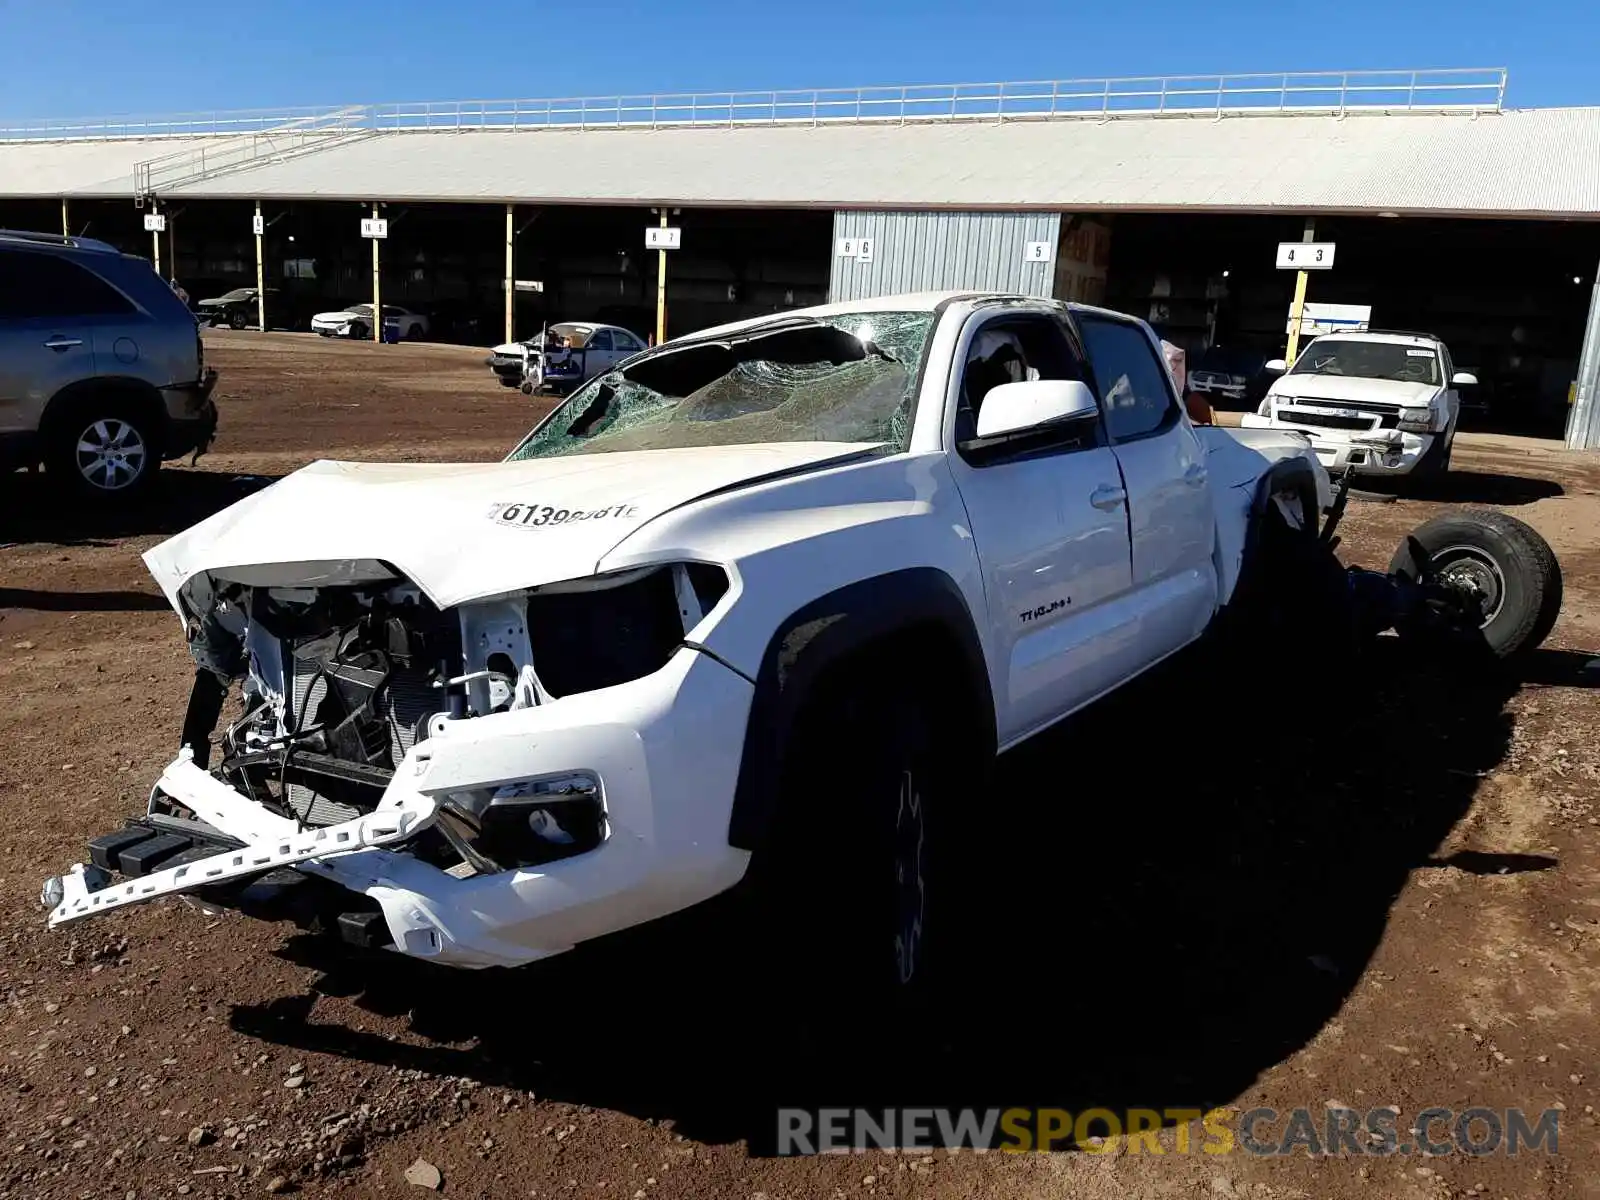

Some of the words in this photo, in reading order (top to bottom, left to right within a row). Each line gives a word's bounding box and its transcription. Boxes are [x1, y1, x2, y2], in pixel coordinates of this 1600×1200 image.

[1035, 246, 1042, 258] 5
[1287, 249, 1295, 262] 4
[1315, 249, 1324, 262] 3
